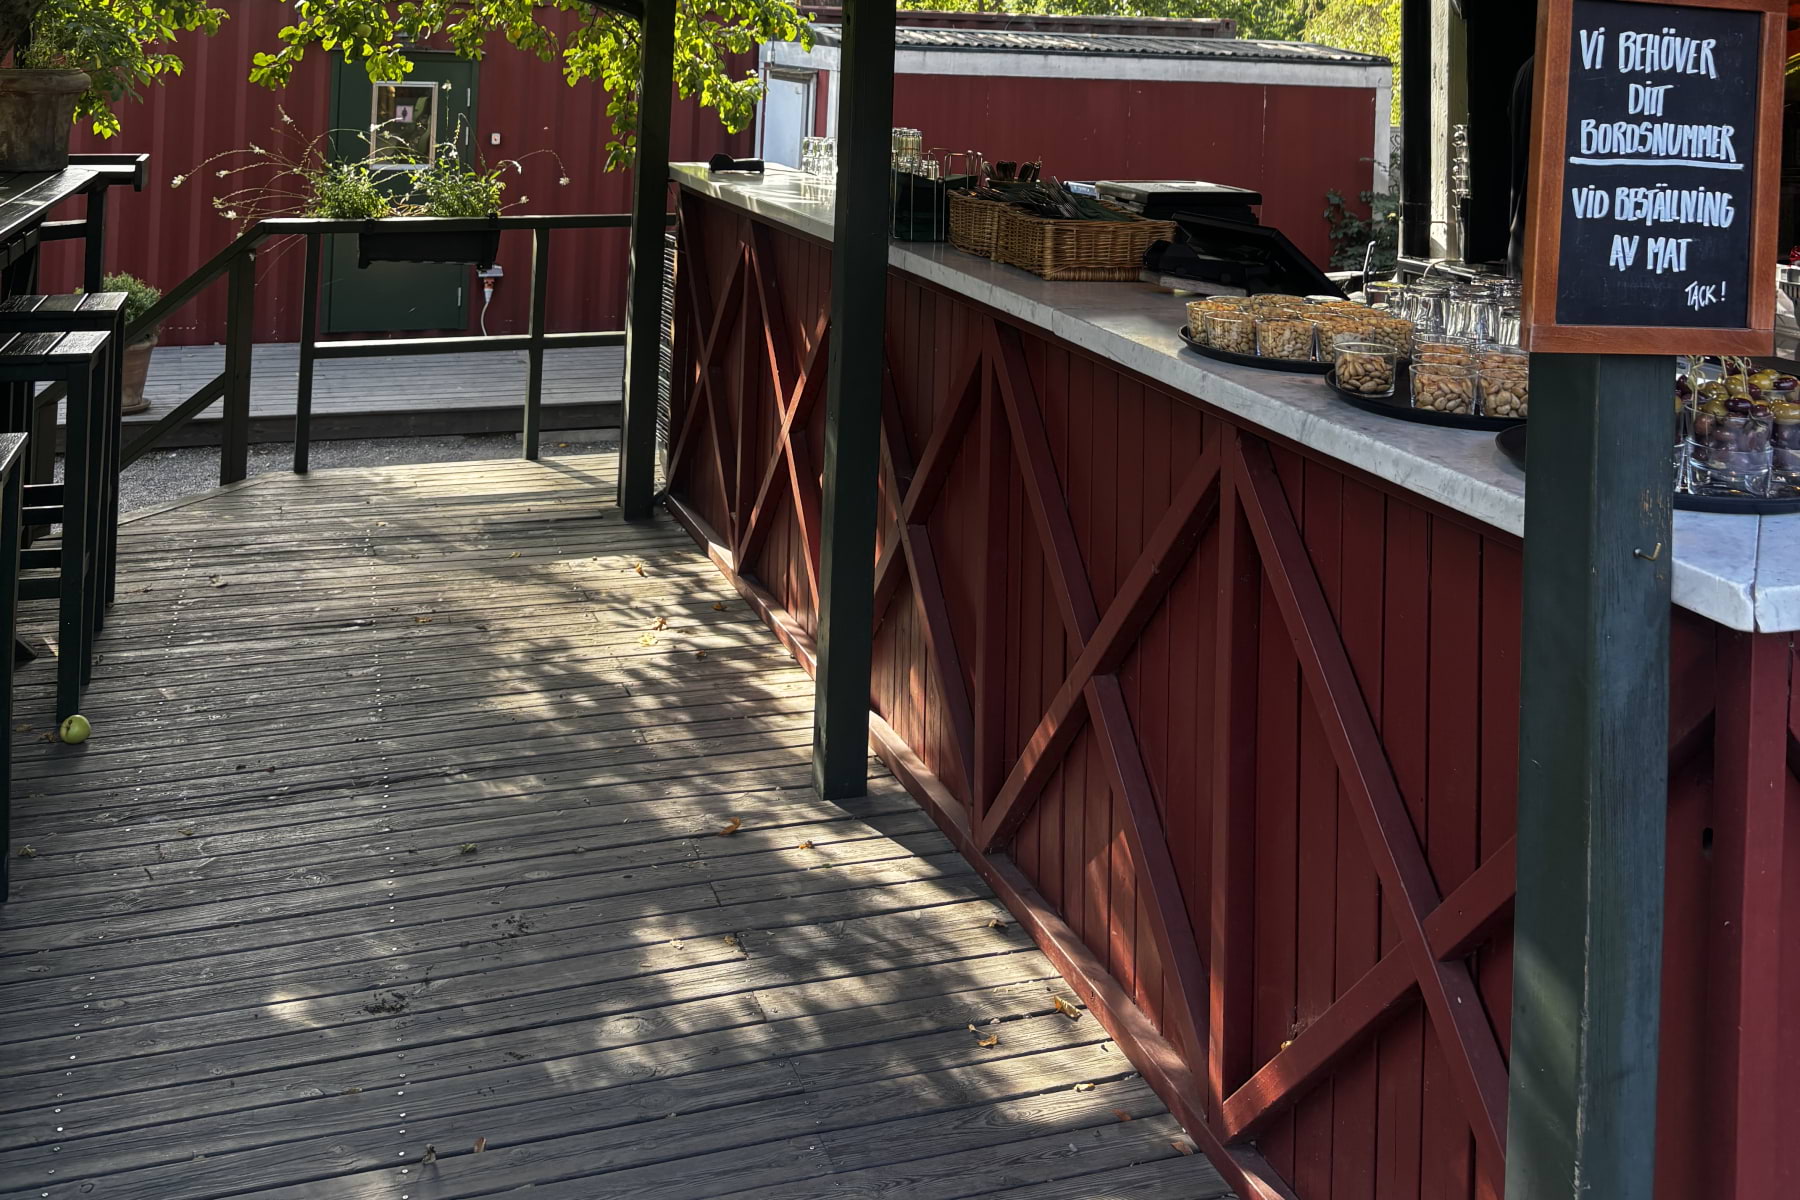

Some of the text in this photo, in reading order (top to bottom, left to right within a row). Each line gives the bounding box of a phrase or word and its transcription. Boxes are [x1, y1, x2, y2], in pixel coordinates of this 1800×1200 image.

[1619, 28, 1718, 79] BEHÖVER
[1581, 119, 1735, 162] BORDSNUMMER
[1609, 234, 1692, 274] AV MAT
